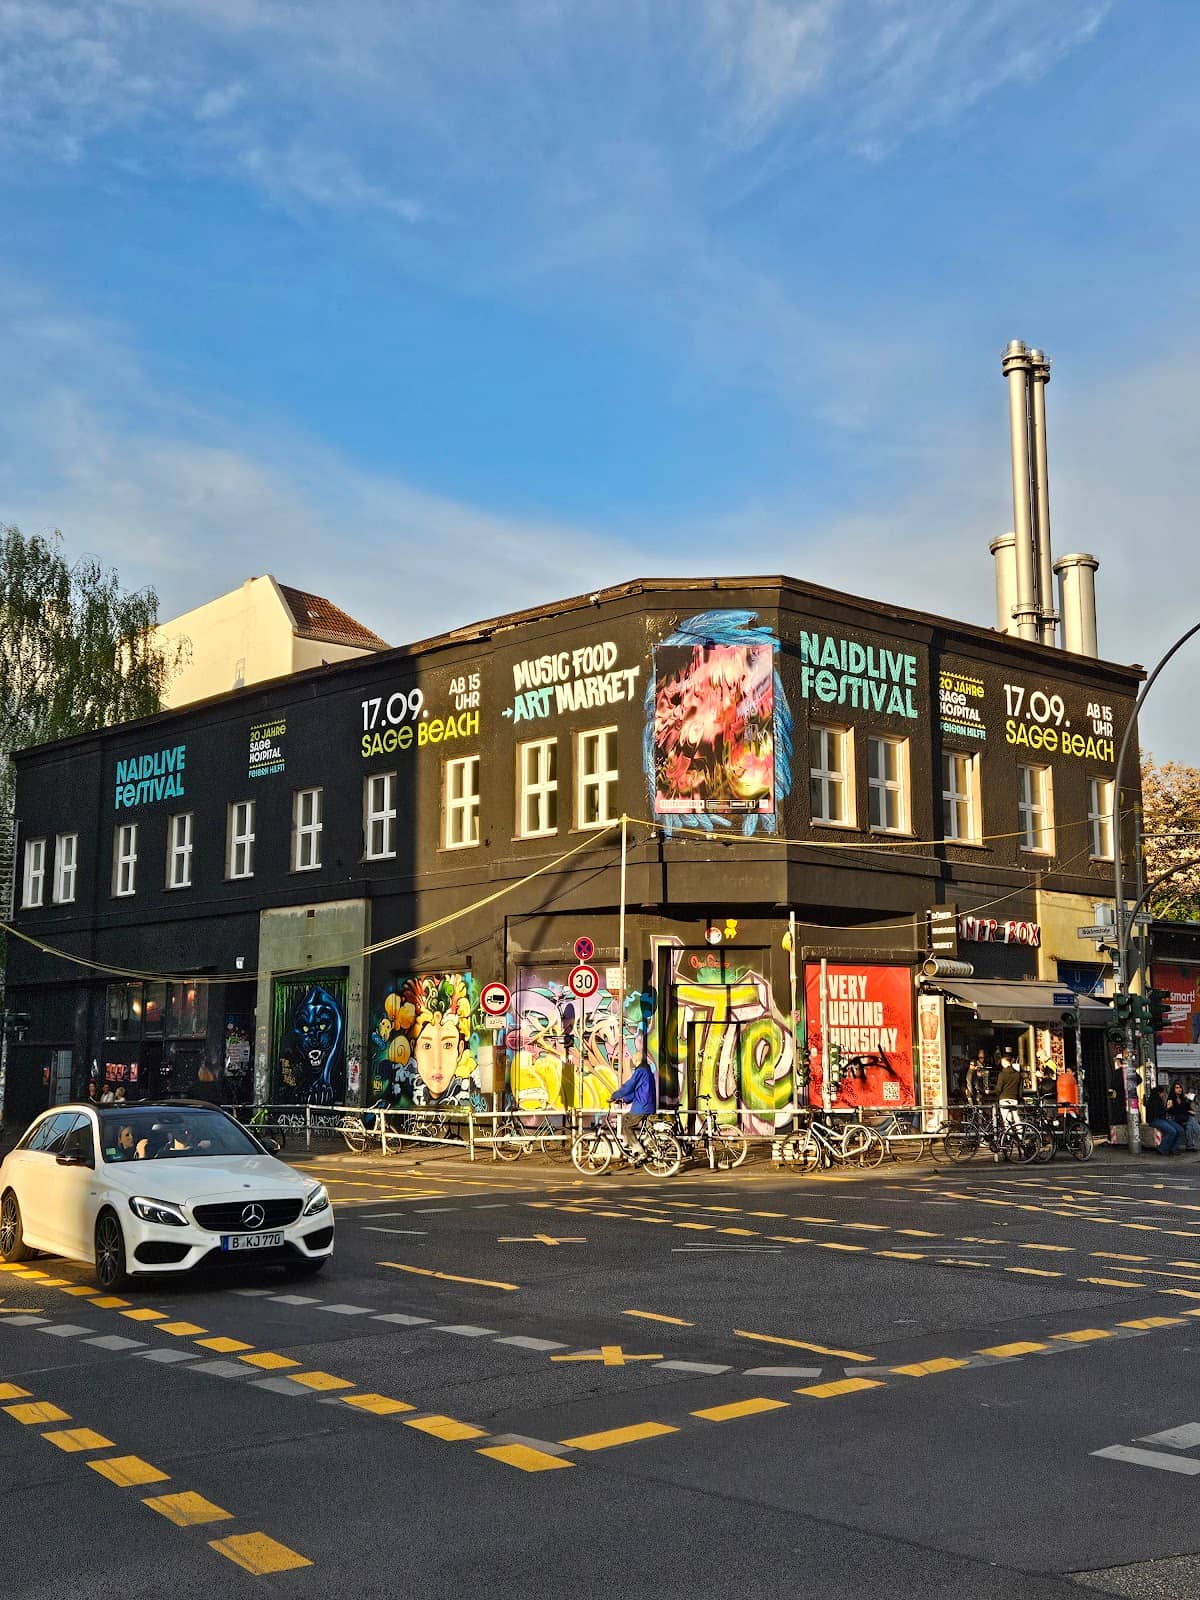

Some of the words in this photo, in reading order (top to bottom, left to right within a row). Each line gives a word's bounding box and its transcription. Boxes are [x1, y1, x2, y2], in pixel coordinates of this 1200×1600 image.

[513, 652, 570, 692] MUSIC
[572, 641, 618, 678] FOOD
[800, 631, 917, 687] NAIDLIVE
[448, 677, 466, 695] AB
[468, 673, 480, 690] 15
[513, 686, 554, 724] ART
[554, 665, 640, 714] MARKET
[939, 676, 953, 690] 20
[361, 688, 429, 731] 17.09.
[455, 691, 480, 711] UHR
[939, 702, 981, 721] HOSPITAL
[1003, 684, 1071, 727] 17.09.
[1086, 703, 1100, 719] AB
[1101, 706, 1113, 721] 15
[250, 730, 261, 742] 20
[1093, 720, 1113, 737] UHR
[115, 745, 186, 785] NAIDLIVE
[249, 747, 281, 763] HOSPITAL
[959, 916, 997, 942] NER
[1003, 920, 1039, 946] BOX
[575, 974, 593, 989] 30
[820, 975, 867, 999] VERY
[820, 1001, 883, 1026] UCKING
[821, 1028, 898, 1053] HURSDAY
[232, 1237, 240, 1249] B
[262, 1233, 281, 1246] 770
